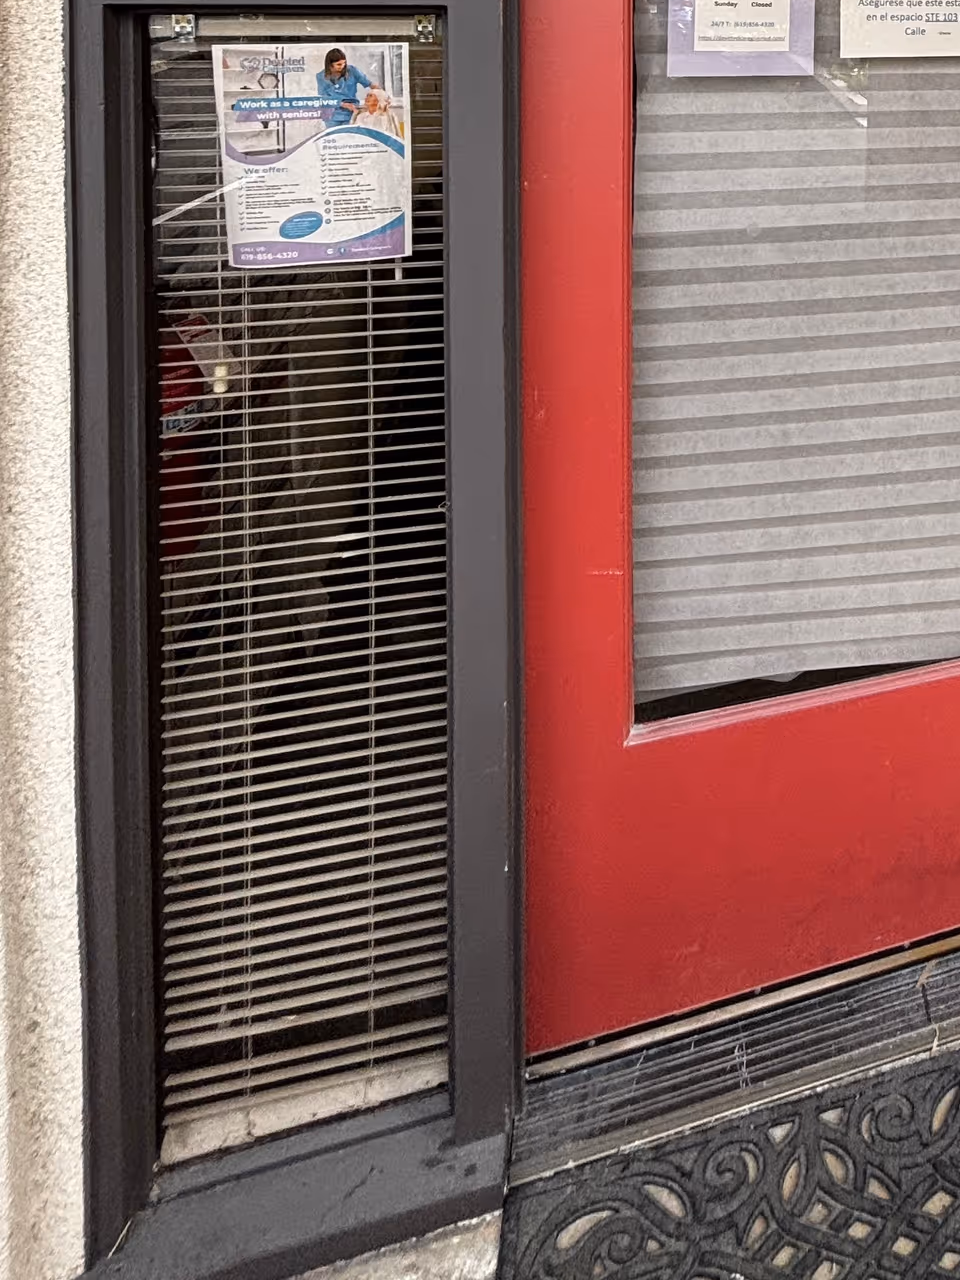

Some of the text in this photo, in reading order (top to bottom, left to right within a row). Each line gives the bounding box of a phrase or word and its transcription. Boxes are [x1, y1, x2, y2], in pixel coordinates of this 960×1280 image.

[906, 0, 922, 9] que
[880, 13, 887, 21] el
[890, 13, 923, 24] espacio
[925, 13, 941, 22] STE
[943, 13, 958, 22] 103
[905, 27, 926, 35] Calle
[263, 57, 305, 66] Devoted
[292, 99, 337, 107] caregiver
[241, 252, 298, 260] 619-856-4320
